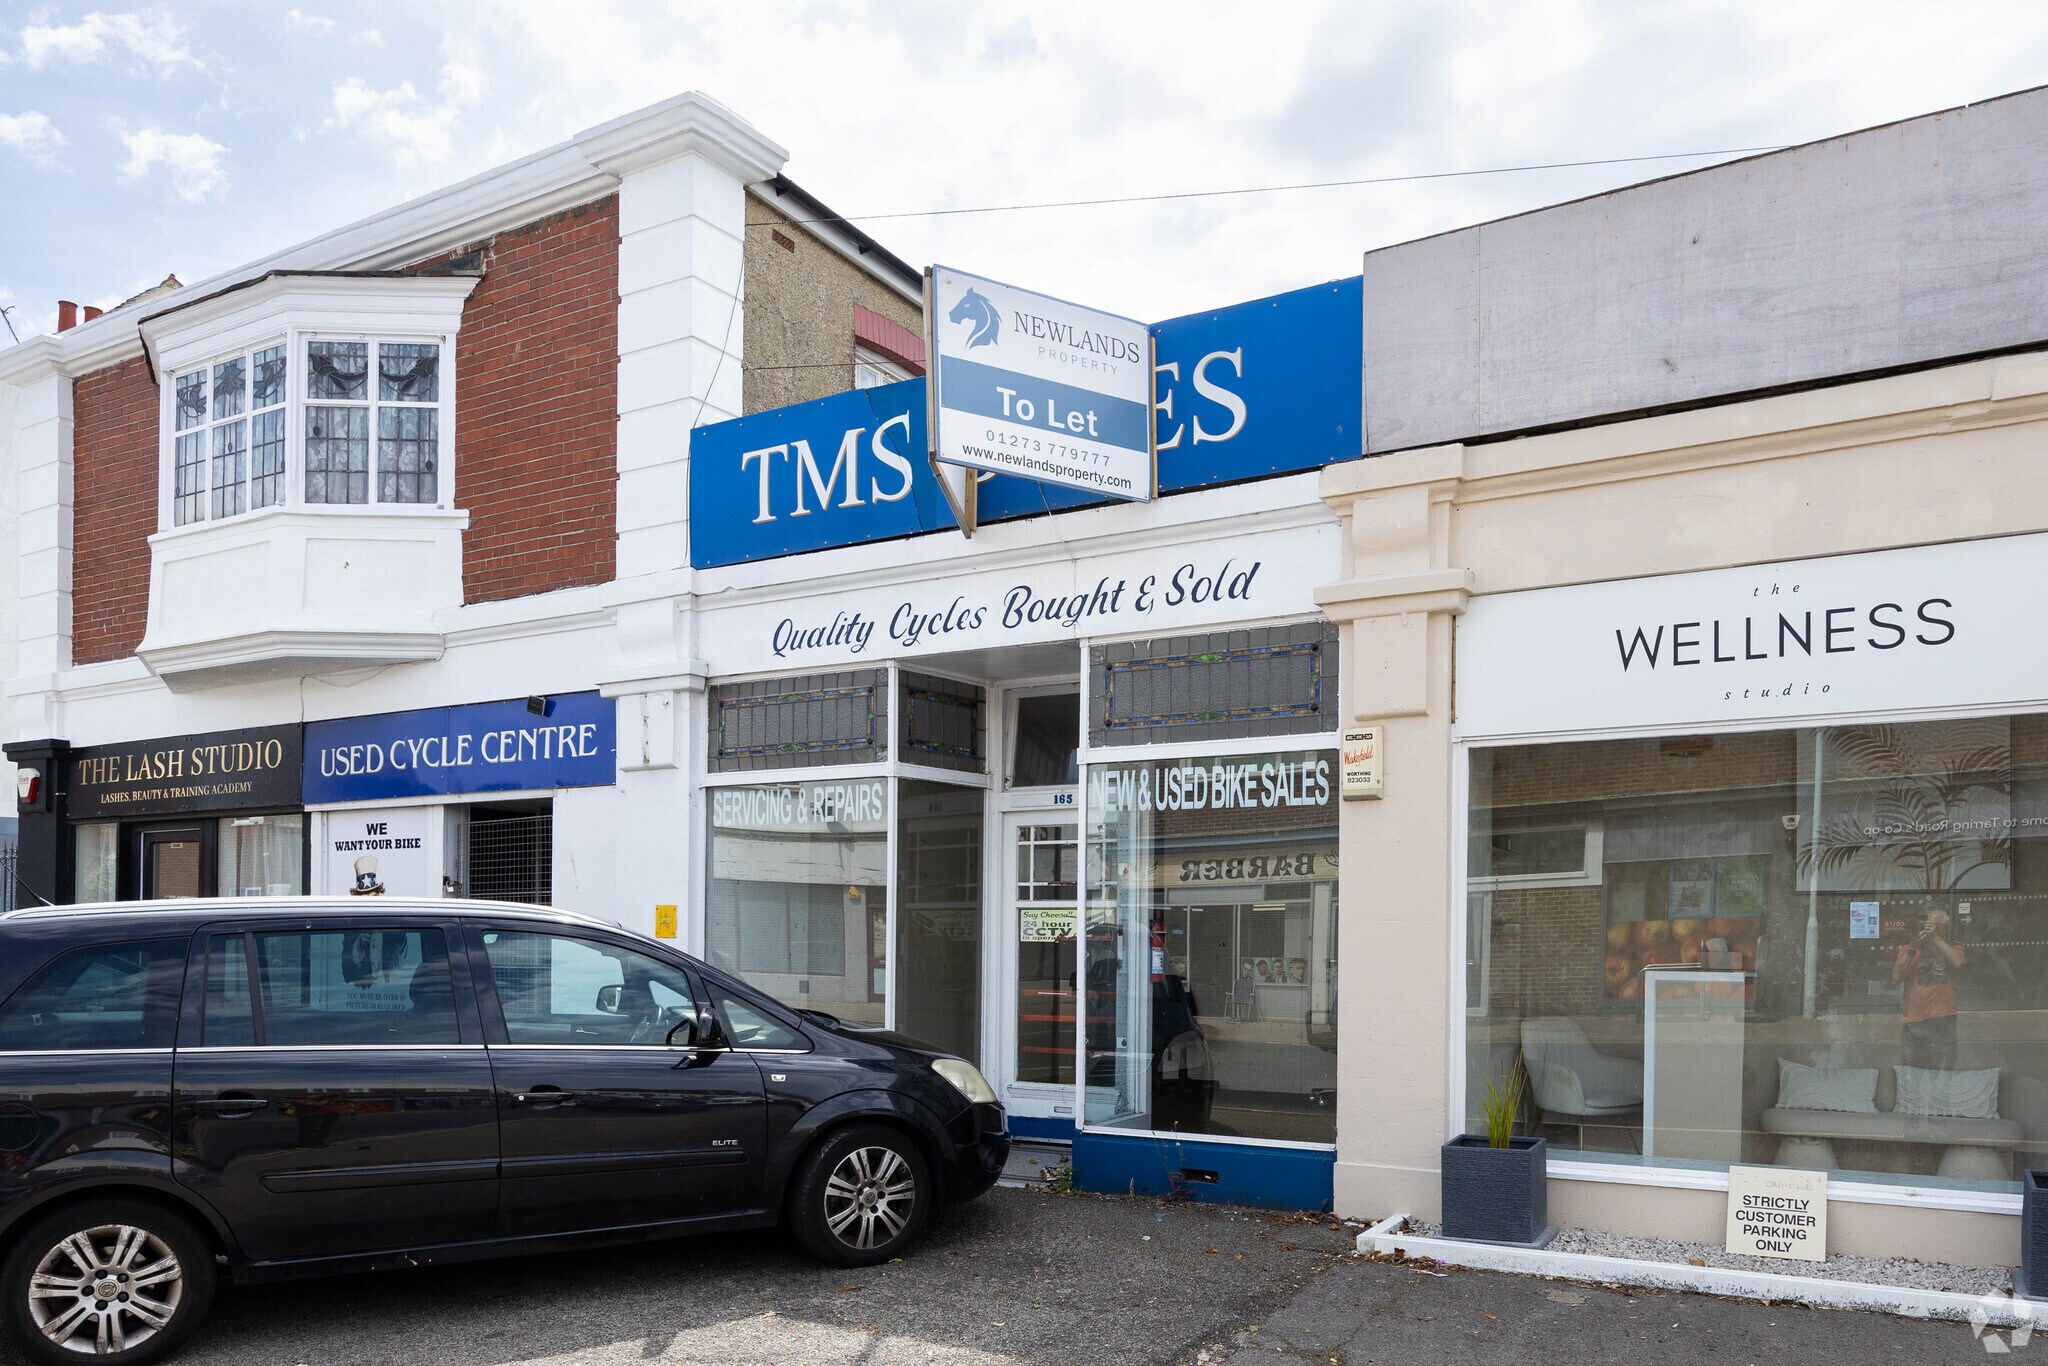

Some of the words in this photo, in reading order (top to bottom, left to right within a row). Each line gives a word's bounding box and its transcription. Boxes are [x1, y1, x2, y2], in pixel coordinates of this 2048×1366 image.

[1013, 311, 1140, 364] NEWLANDS
[1038, 346, 1118, 376] PROPERTY
[996, 386, 1035, 421] To
[1048, 398, 1098, 437] Let
[986, 429, 1042, 452] 01273
[1048, 443, 1111, 467] 779777
[741, 409, 915, 525] TMS
[962, 444, 1132, 489] www.newlandsproperty.com
[1753, 582, 1801, 597] the
[772, 611, 875, 658] Quality
[889, 595, 987, 647] Cycles
[1001, 576, 1126, 629] Bought
[1135, 575, 1157, 615] &
[1164, 558, 1262, 607] Sold
[1615, 598, 1955, 673] WELLNESS
[1724, 682, 1830, 700] studio
[320, 744, 384, 777] USED
[389, 734, 473, 770] CYCLE
[480, 723, 598, 763] CENTRE
[78, 756, 120, 786] THE
[125, 749, 184, 782] LASH
[190, 739, 283, 776] STUDIO
[101, 791, 131, 804] LASHES,
[132, 788, 163, 801] BEAUTY
[163, 790, 169, 799] &
[170, 785, 210, 798] TRAINING
[211, 781, 253, 795] ACADEMY
[1093, 769, 1136, 812] NEW
[1138, 768, 1152, 811] &
[1155, 766, 1208, 811] USED
[1211, 764, 1257, 808] BIKE
[1261, 759, 1330, 807] SALES
[713, 788, 792, 827] SERVICING
[797, 787, 808, 824] &
[813, 782, 883, 823] REPAIRS
[1054, 794, 1073, 804] 165
[366, 822, 388, 836] WE
[335, 840, 364, 852] WANT
[365, 839, 393, 850] YOUR
[394, 838, 421, 850] BIKE
[1023, 911, 1039, 920] Say
[1041, 920, 1072, 928] hour
[1022, 927, 1073, 936] CCTV
[1743, 1194, 1809, 1210] STRICTLY
[1736, 1210, 1816, 1227] CUSTOMER
[1743, 1224, 1806, 1240] PARKING
[1755, 1239, 1792, 1252] ONLY
